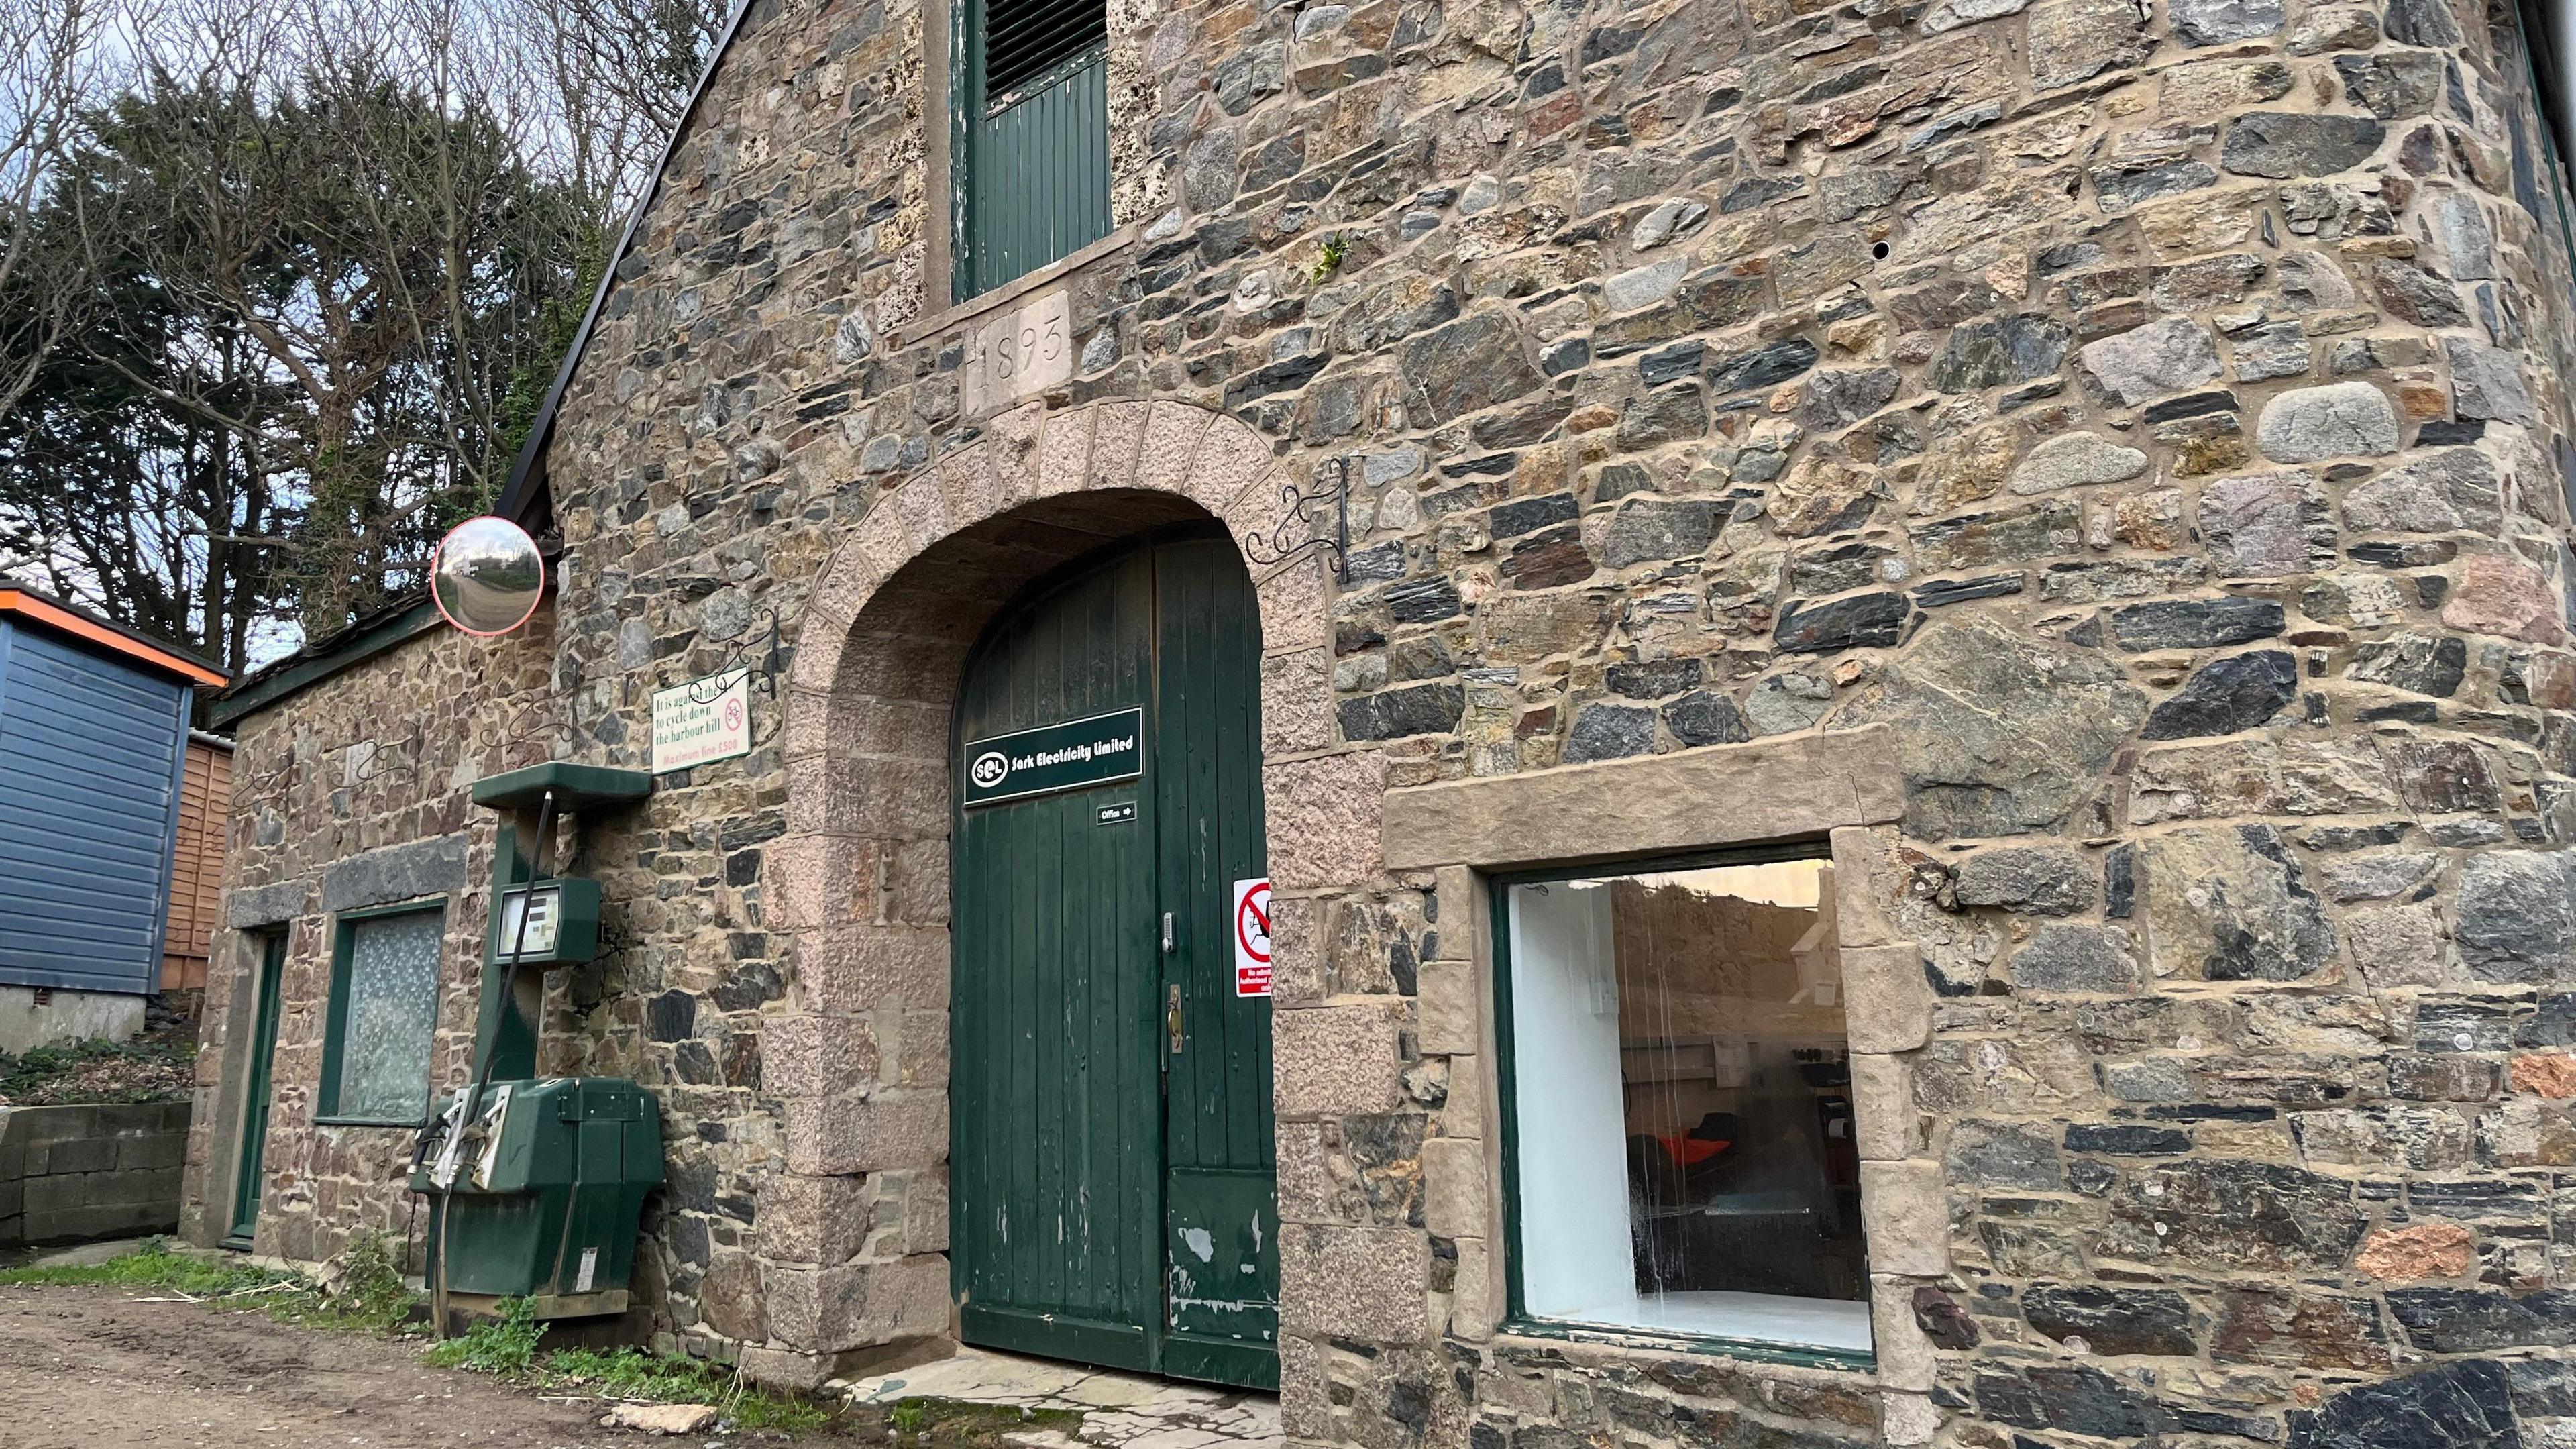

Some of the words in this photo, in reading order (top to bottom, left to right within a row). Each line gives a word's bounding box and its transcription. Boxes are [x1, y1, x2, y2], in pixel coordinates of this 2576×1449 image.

[979, 315, 1062, 387] 1893
[657, 700, 663, 712] It
[665, 698, 672, 709] is
[705, 686, 718, 698] the
[657, 719, 664, 729] to
[667, 710, 687, 728] cycle
[689, 706, 710, 720] down
[656, 733, 669, 745] the
[672, 726, 704, 742] harbour
[706, 718, 720, 733] hill
[664, 751, 699, 765] Maximum
[702, 746, 716, 757] fine
[719, 739, 737, 752] £500
[1012, 755, 1034, 771] Sark
[1036, 745, 1091, 766] Electricity
[1094, 735, 1134, 755] Limited
[1102, 810, 1120, 819] Office
[1248, 969, 1256, 977] No
